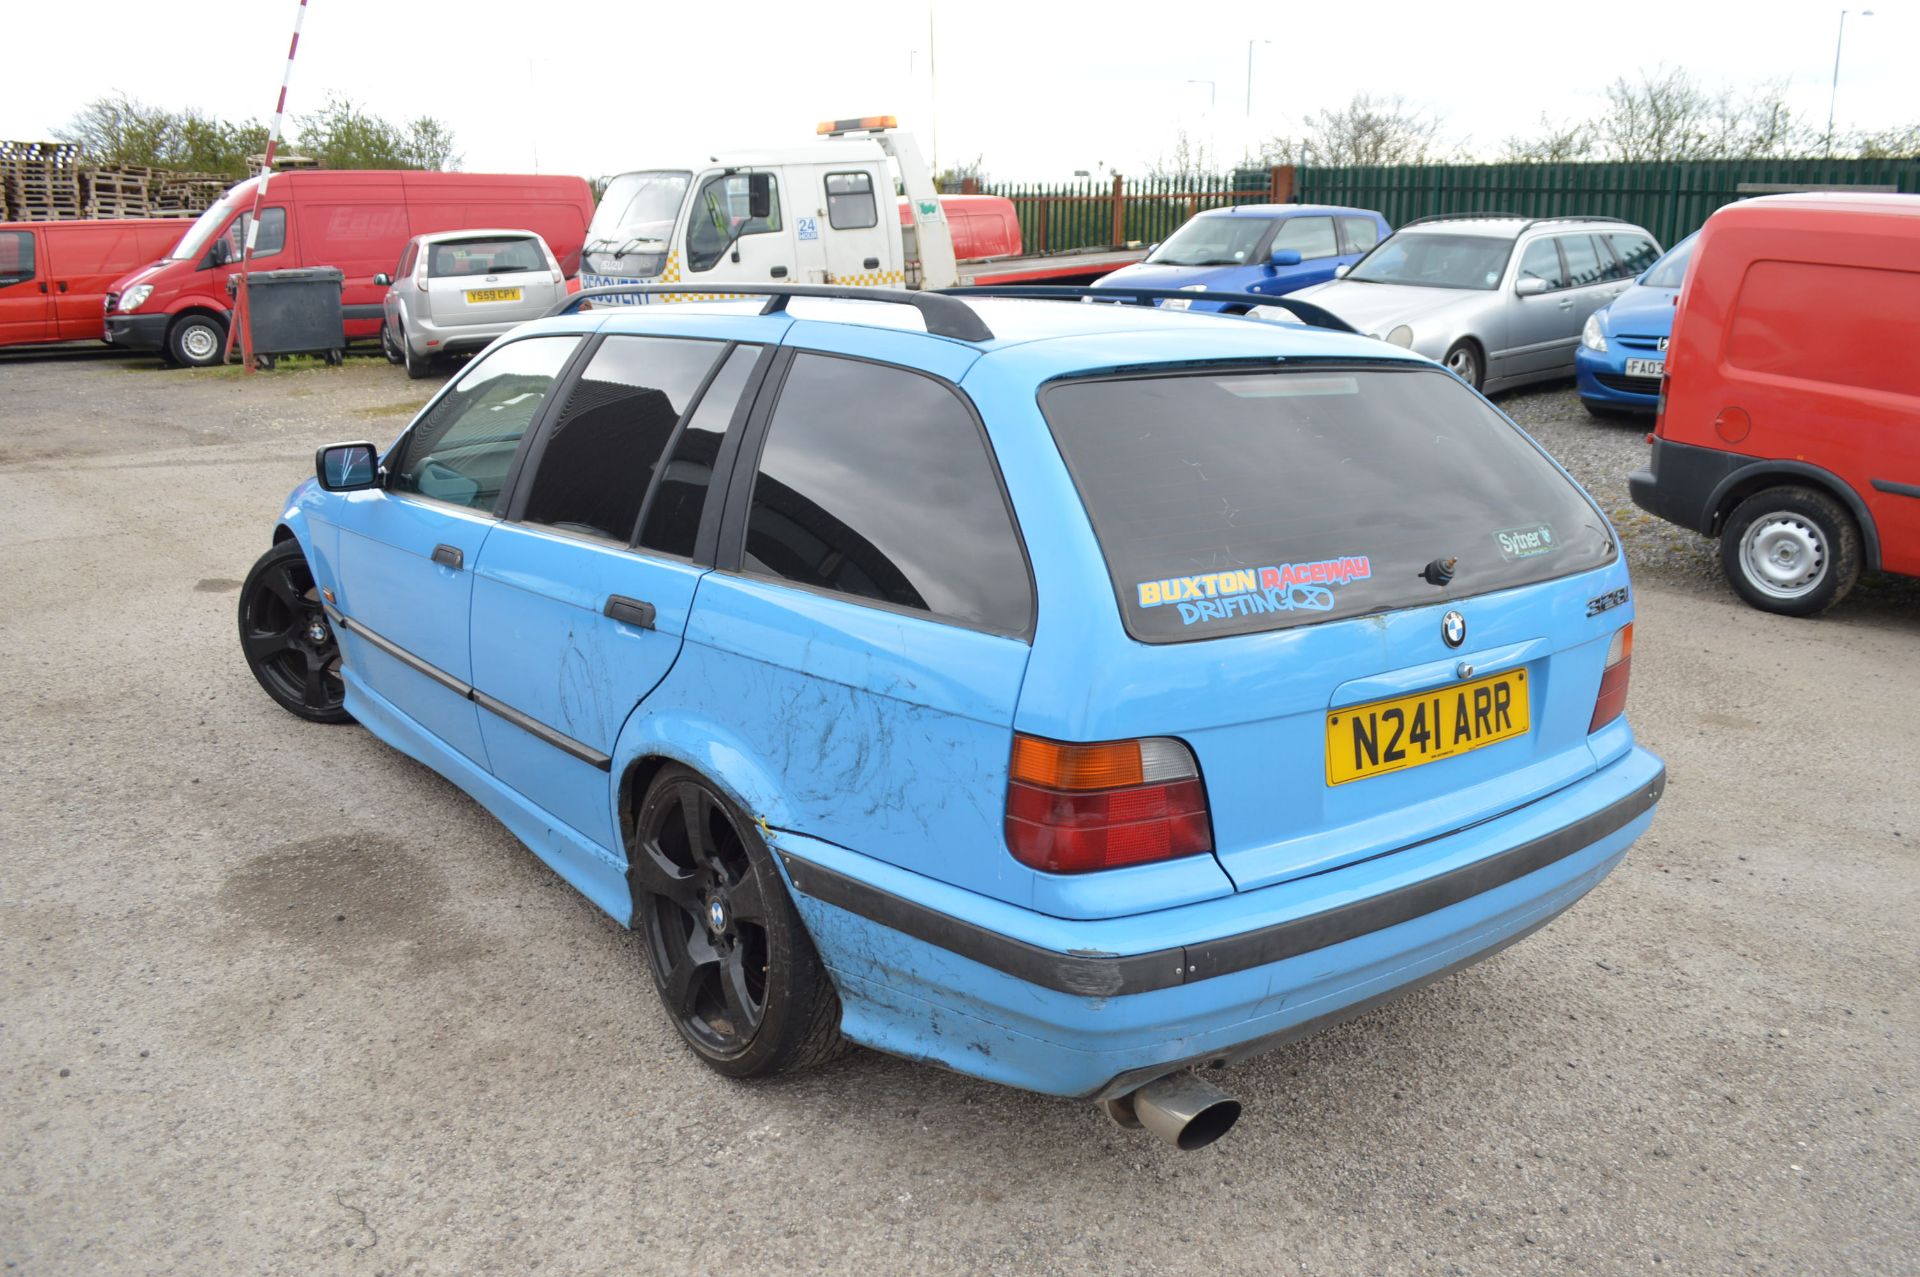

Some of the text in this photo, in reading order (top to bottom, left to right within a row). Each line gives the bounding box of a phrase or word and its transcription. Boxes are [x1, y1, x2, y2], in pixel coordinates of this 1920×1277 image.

[799, 219, 815, 231] 24
[600, 260, 624, 270] ISUZU
[471, 288, 517, 301] YS59 CPY
[1631, 360, 1665, 375] FA03
[1499, 530, 1542, 555] Sytner
[1138, 569, 1258, 608] BUXTON
[1177, 587, 1294, 625] DRIFTING
[1352, 681, 1512, 770] N241 ARR
